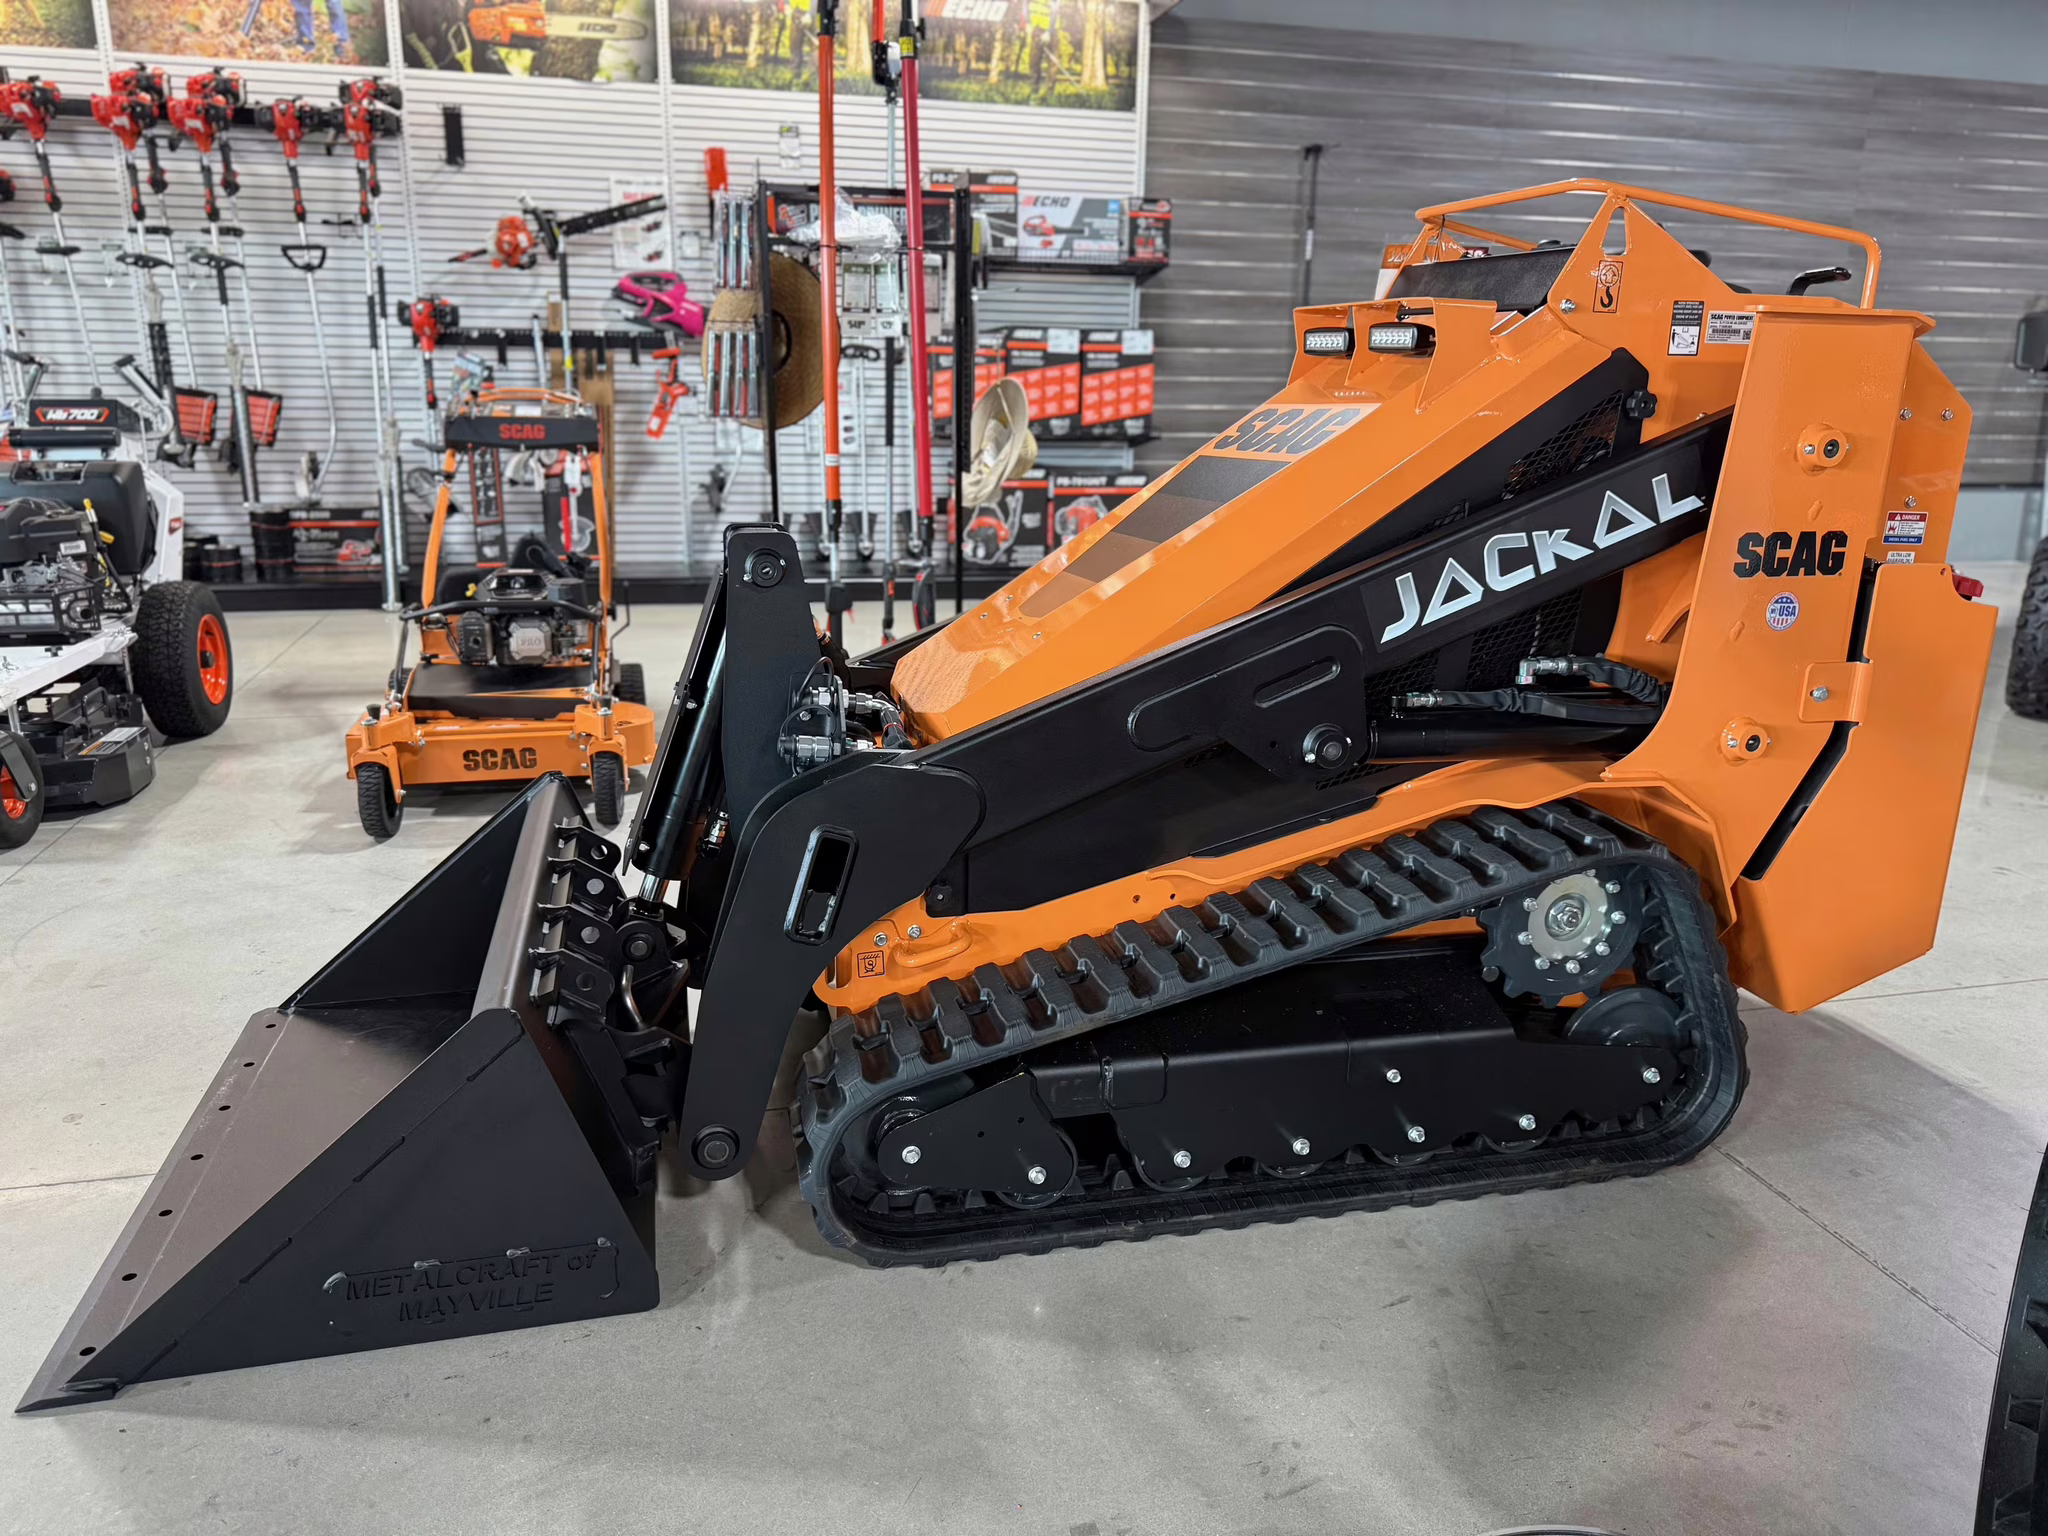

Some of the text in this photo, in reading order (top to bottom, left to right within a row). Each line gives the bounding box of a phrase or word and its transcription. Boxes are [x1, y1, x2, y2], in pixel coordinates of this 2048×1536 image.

[943, 0, 1009, 21] ECHO
[1033, 196, 1070, 208] ECHO
[500, 424, 546, 440] SCAG
[1213, 408, 1361, 454] SCAG
[1381, 473, 1704, 643] JACKAL
[1733, 530, 1849, 578] SCAG
[1778, 605, 1797, 617] USA
[462, 747, 538, 771] SCAG
[346, 1254, 559, 1301] METALCRAFT
[400, 1283, 554, 1322] MAYVILLE
